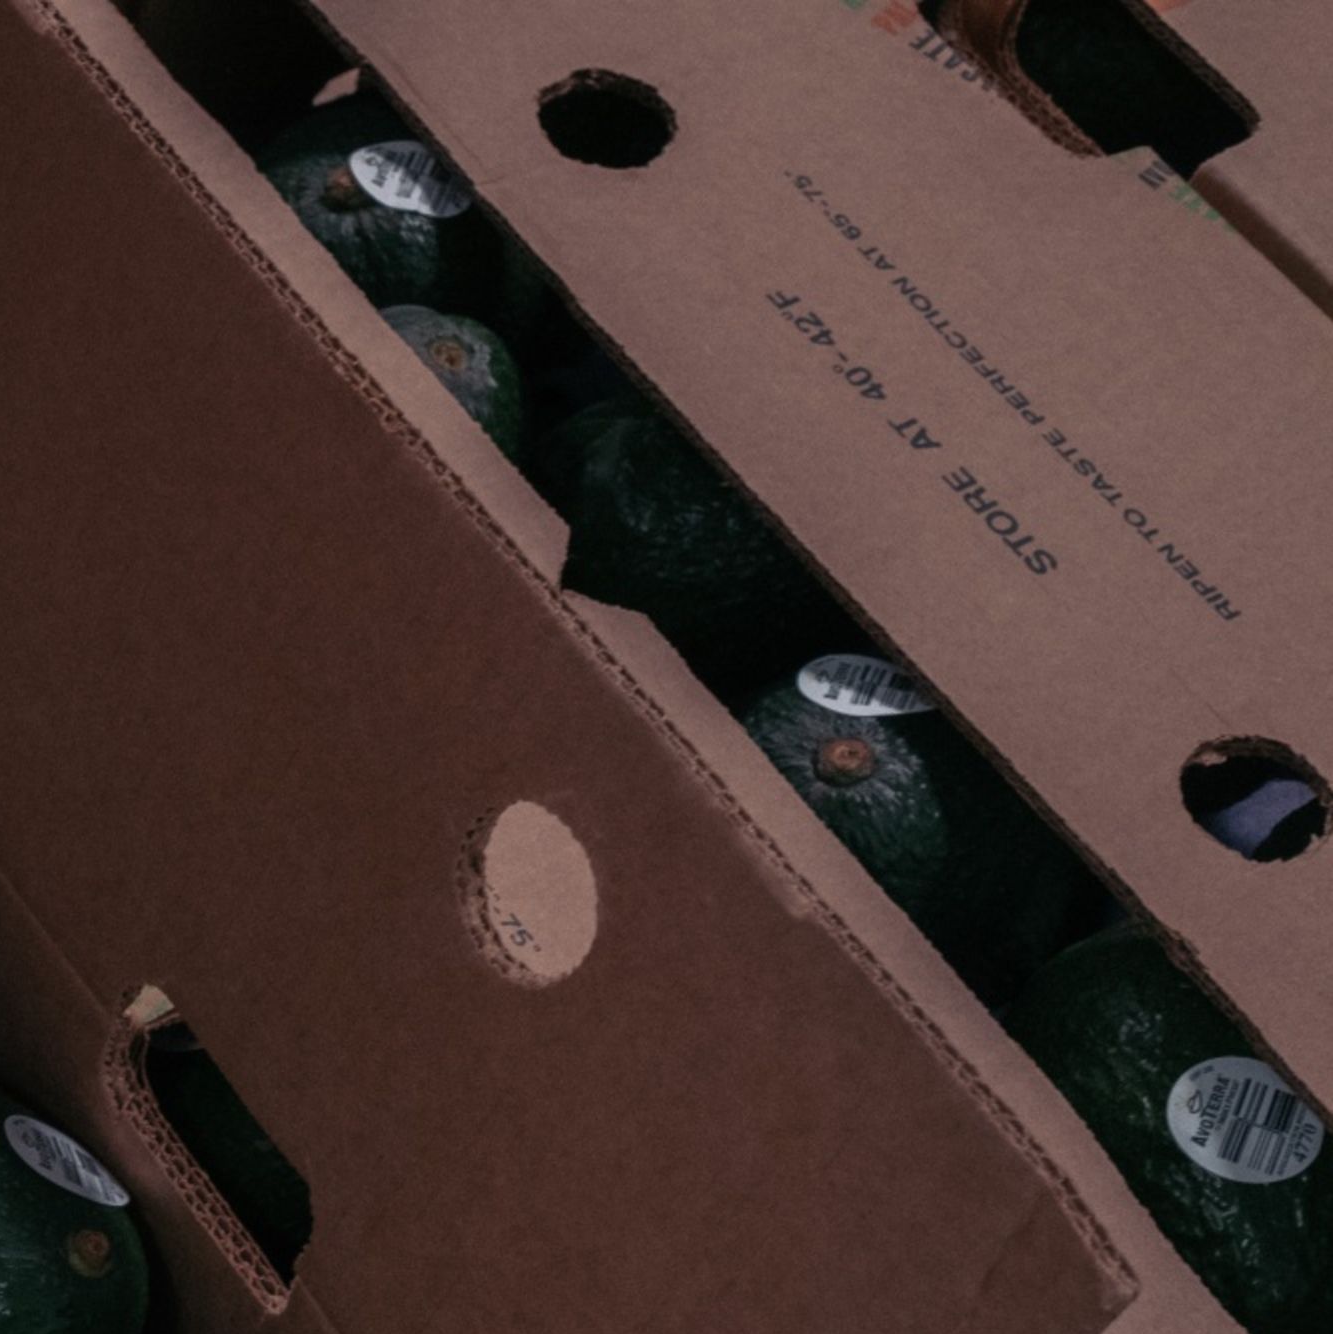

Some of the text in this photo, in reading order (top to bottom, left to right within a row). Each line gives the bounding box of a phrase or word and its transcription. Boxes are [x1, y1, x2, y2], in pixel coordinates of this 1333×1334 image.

[858, 246, 897, 273] AT
[892, 276, 1044, 427] PERFECTION
[890, 417, 942, 451] AT
[1043, 428, 1124, 508] TASTE
[942, 466, 1058, 576] STORE
[1123, 508, 1159, 543] TO
[1158, 542, 1241, 622] RIPEN
[1294, 1123, 1317, 1163] 4770
